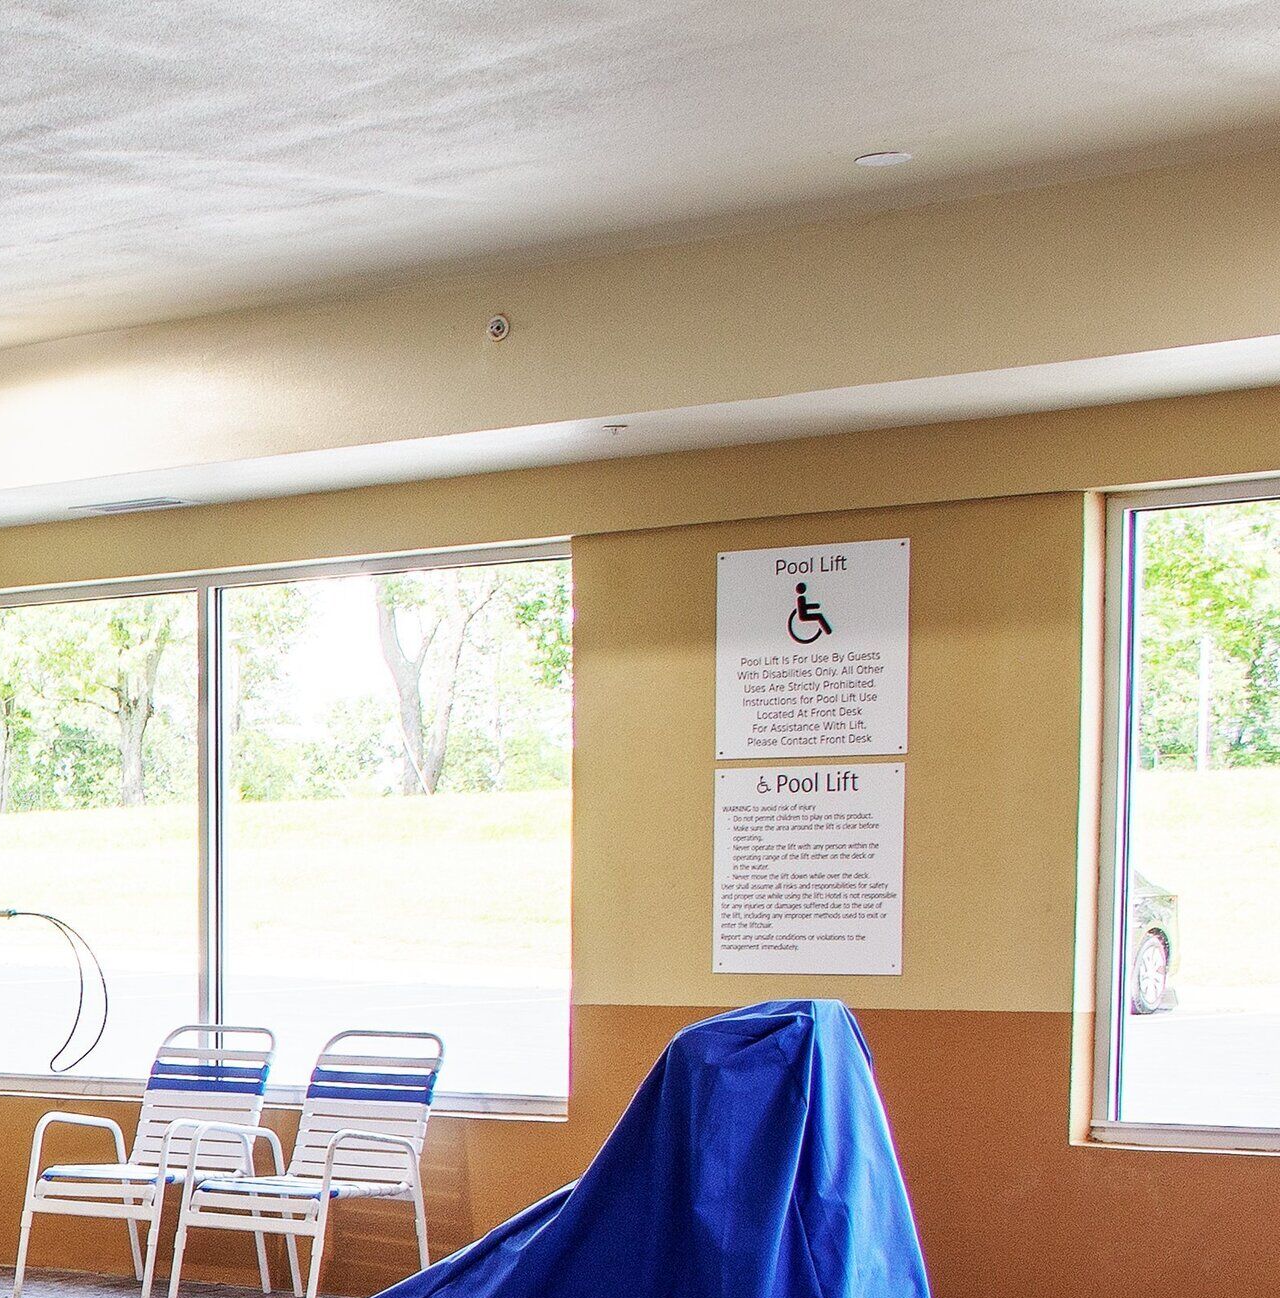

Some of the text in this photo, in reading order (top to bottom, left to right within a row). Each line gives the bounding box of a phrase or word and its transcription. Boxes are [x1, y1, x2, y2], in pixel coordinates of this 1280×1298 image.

[776, 554, 847, 575] Pool Lift
[741, 651, 880, 666] Pool Lift Is For Use By Guests
[737, 664, 884, 680] With Disabilities Only. All Other
[744, 679, 876, 693] Uses Are Strictly Prohibited.
[742, 692, 877, 707] Instructions for Pool Lift Use
[756, 706, 863, 720] Located At Front Desk
[752, 720, 867, 733] For Assistance With Lift.
[747, 733, 872, 747] Please Contact Front Desk
[777, 771, 859, 793] Pool Lift
[799, 804, 816, 812] injury
[755, 815, 775, 823] permit
[810, 813, 822, 821] play
